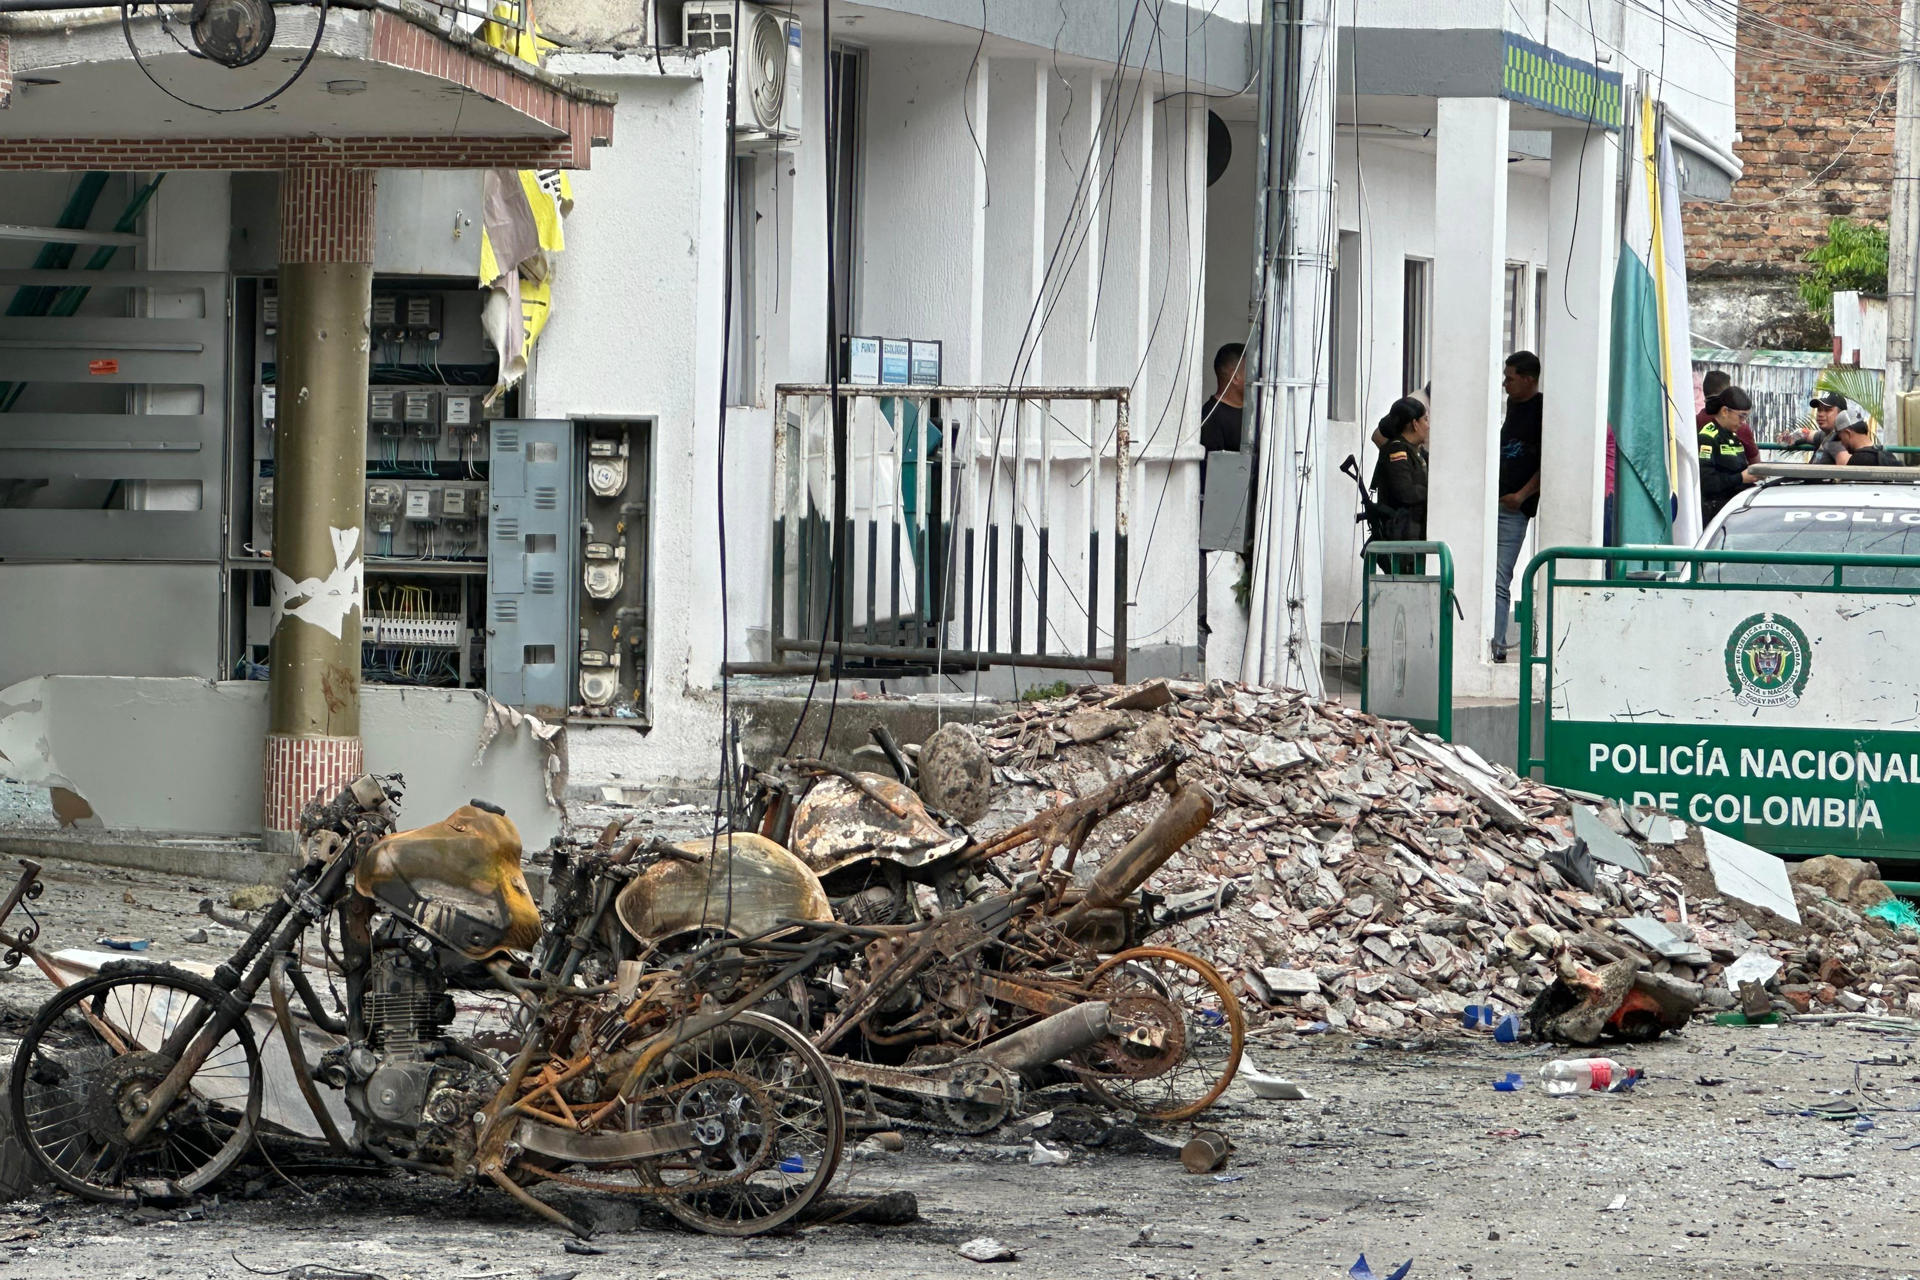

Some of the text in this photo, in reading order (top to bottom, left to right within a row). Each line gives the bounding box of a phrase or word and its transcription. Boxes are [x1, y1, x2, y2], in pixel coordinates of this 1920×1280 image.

[861, 342, 876, 354] PUNTO
[1589, 739, 1920, 783] POLICÍA NACIONAL
[1689, 793, 1883, 829] COLOMBIA
